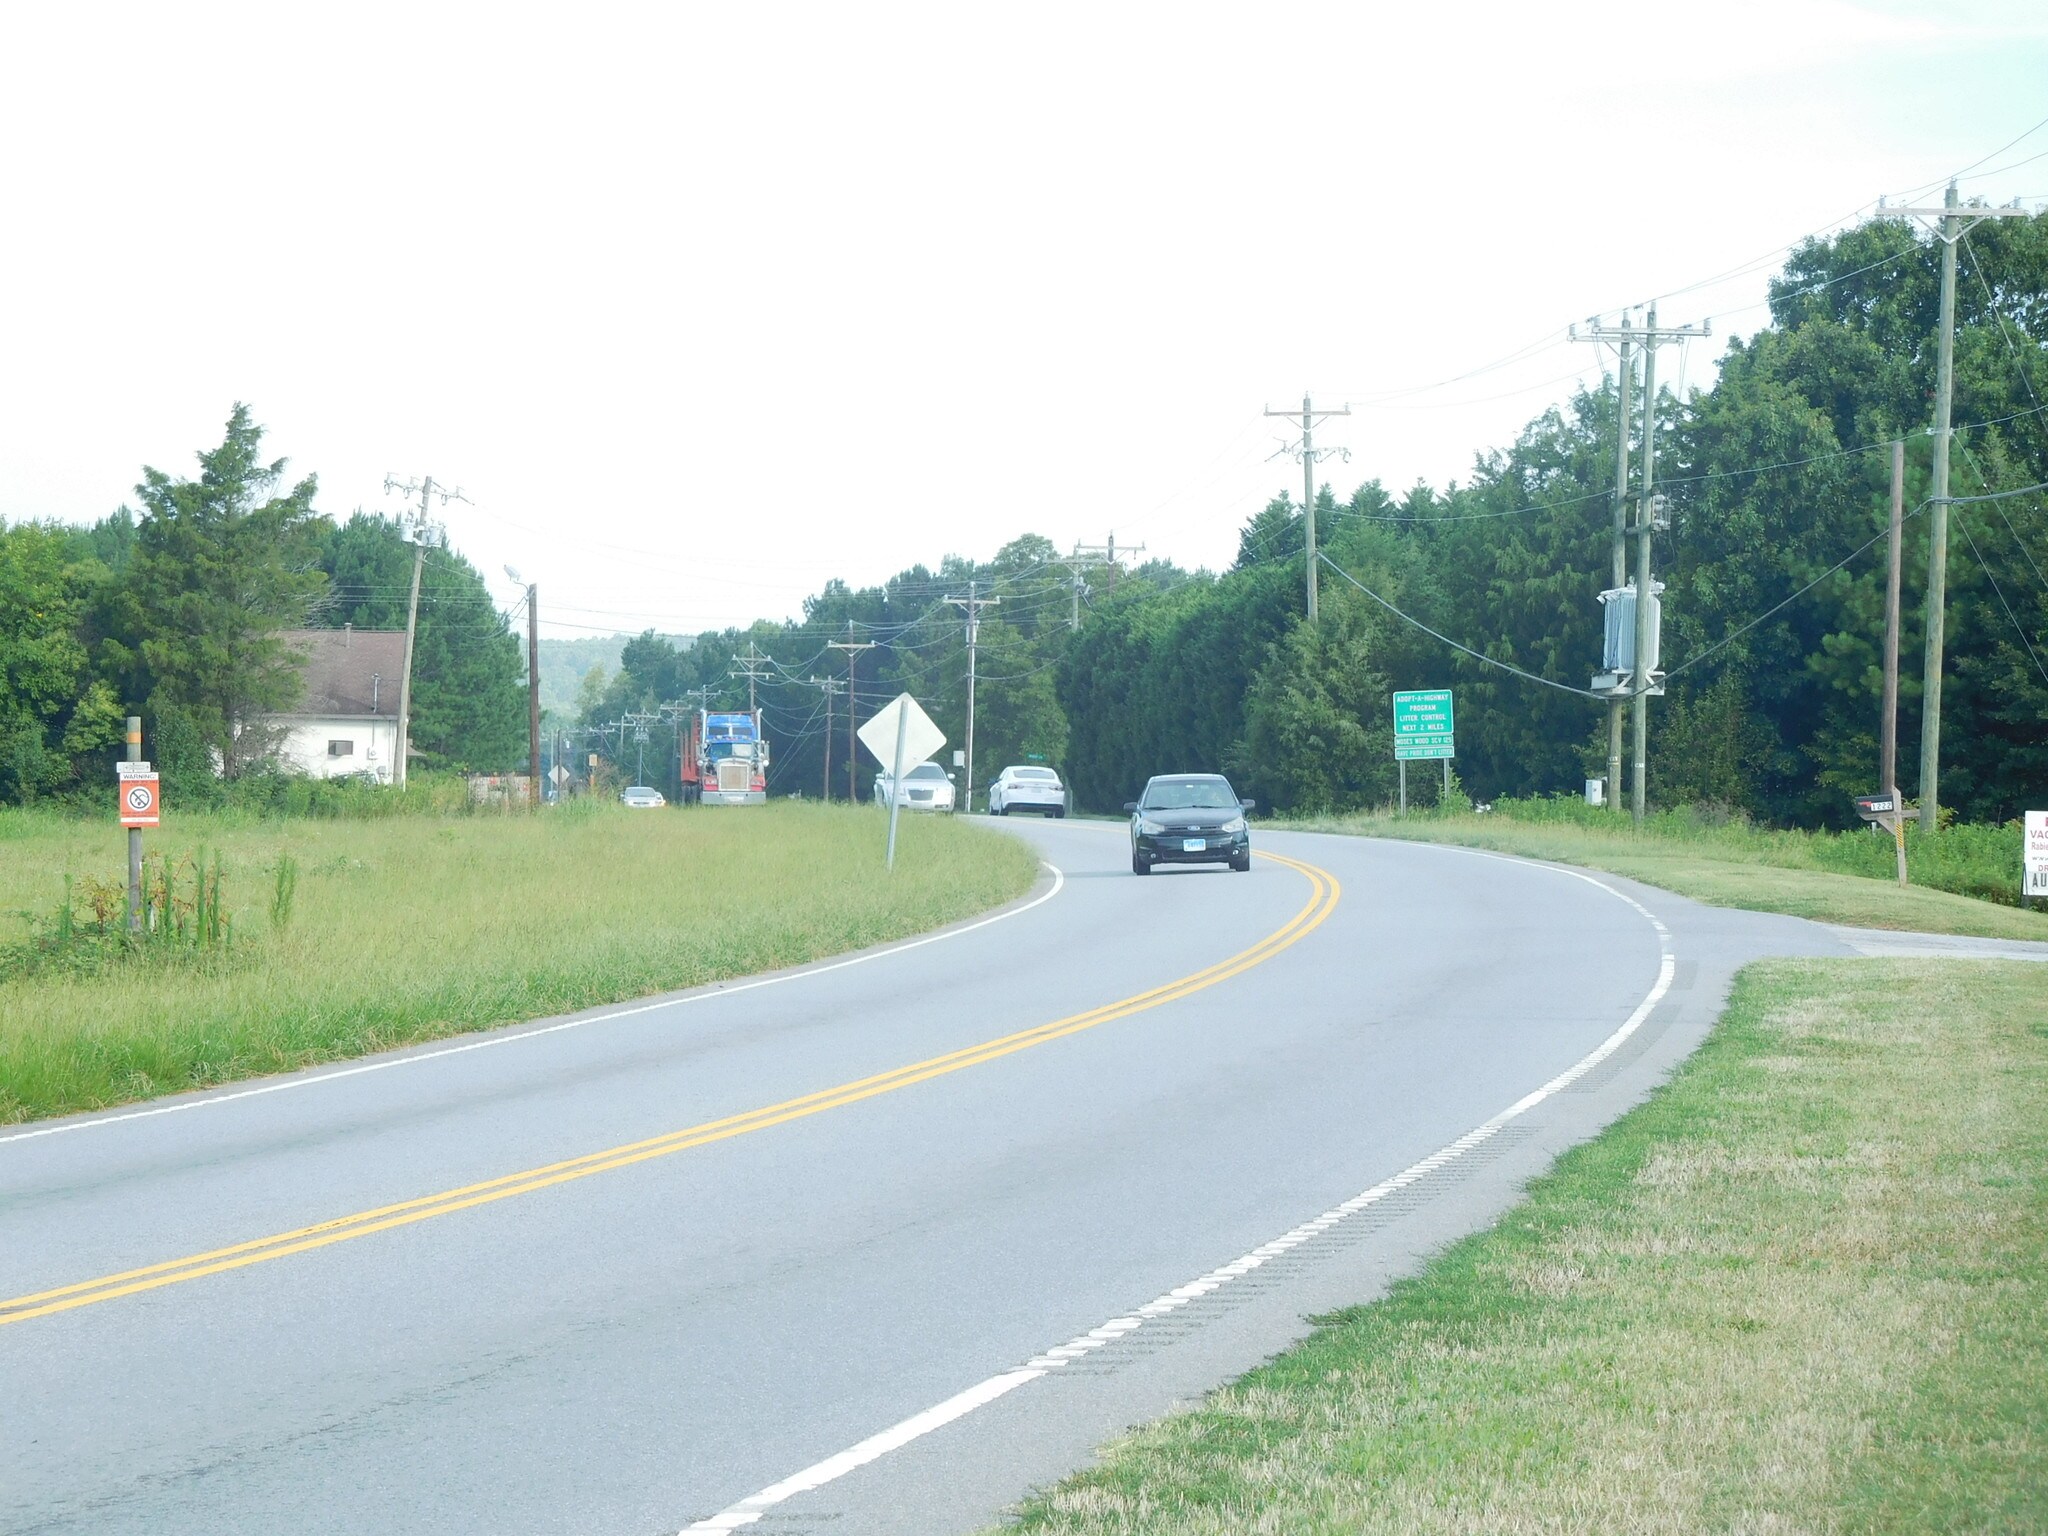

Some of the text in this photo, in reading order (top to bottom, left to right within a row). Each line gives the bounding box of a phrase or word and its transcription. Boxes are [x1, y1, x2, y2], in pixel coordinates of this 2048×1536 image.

[1397, 694, 1448, 702] ADOPT-A-HIGHWAY
[1872, 802, 1891, 810] 1222
[2032, 873, 2047, 887] AU
